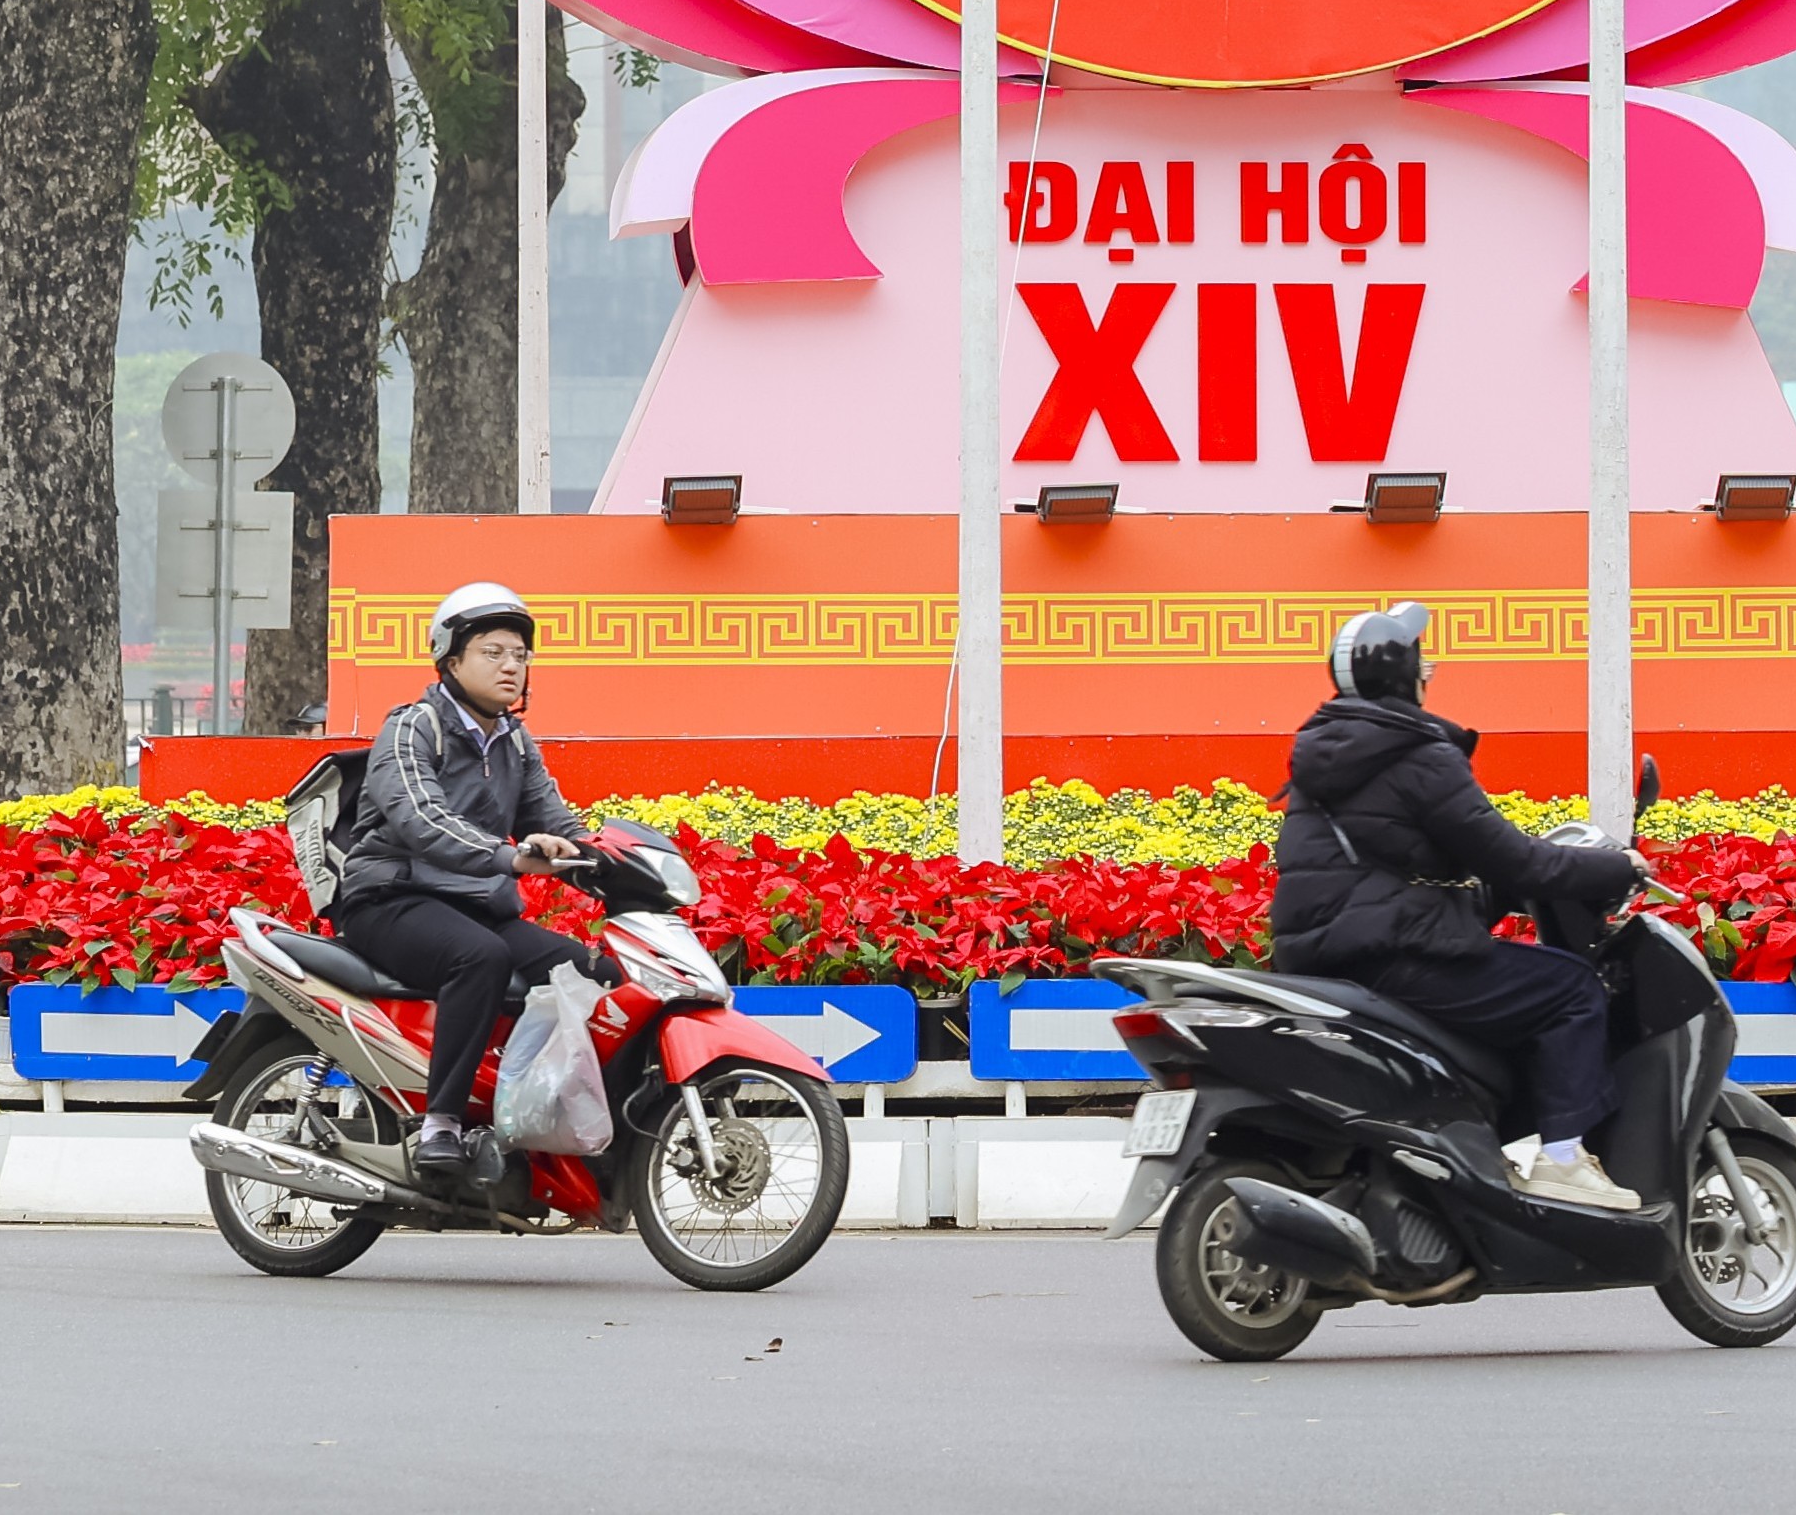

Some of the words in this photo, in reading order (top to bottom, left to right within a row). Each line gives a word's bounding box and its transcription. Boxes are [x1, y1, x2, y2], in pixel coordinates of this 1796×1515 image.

[1004, 161, 1195, 263] ĐẠI
[1240, 142, 1427, 264] HỘI
[1012, 282, 1427, 464] XIV
